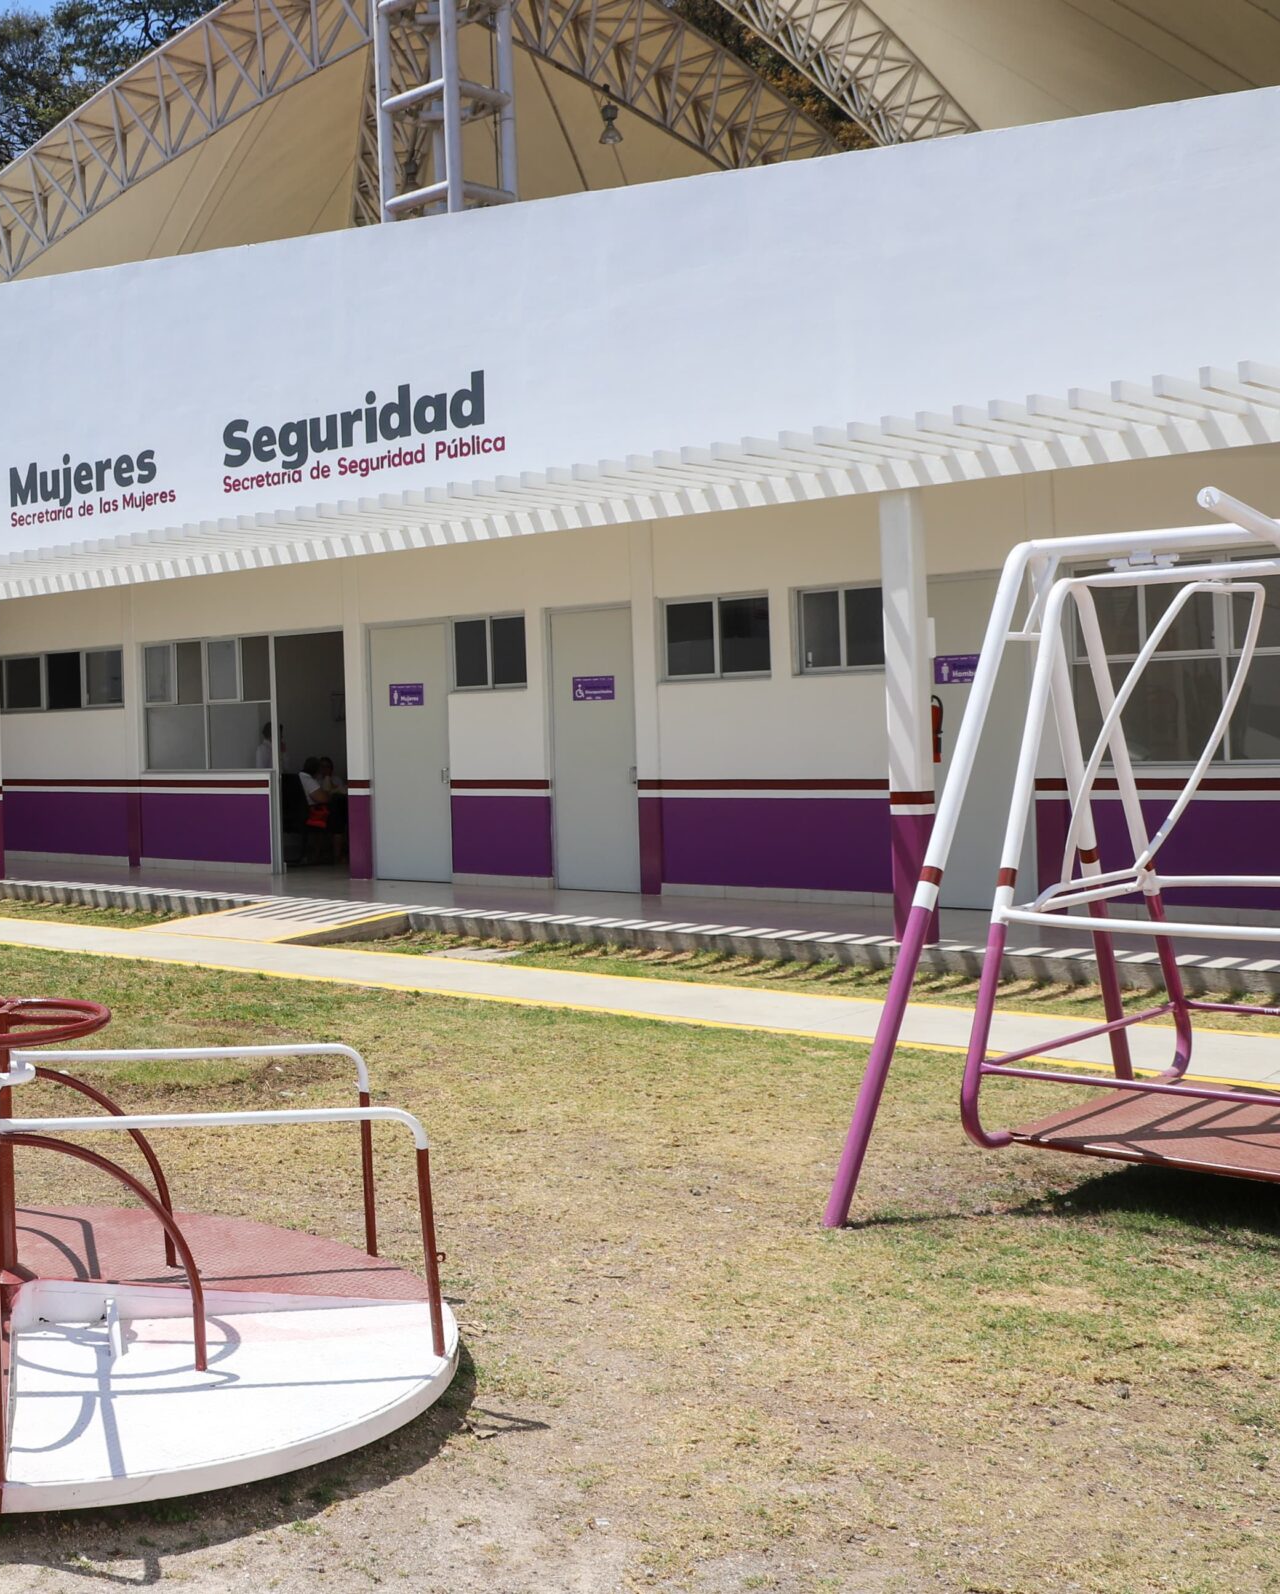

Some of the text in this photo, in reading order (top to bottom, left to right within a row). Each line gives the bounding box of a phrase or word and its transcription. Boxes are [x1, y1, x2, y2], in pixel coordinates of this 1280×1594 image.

[222, 369, 485, 470] Seguridad
[9, 449, 157, 508] Mujeres
[310, 460, 331, 480] de
[337, 443, 425, 477] Seguridad
[435, 435, 506, 461] Pública
[78, 500, 94, 517] de
[99, 497, 119, 514] las
[122, 489, 176, 512] Mujeres
